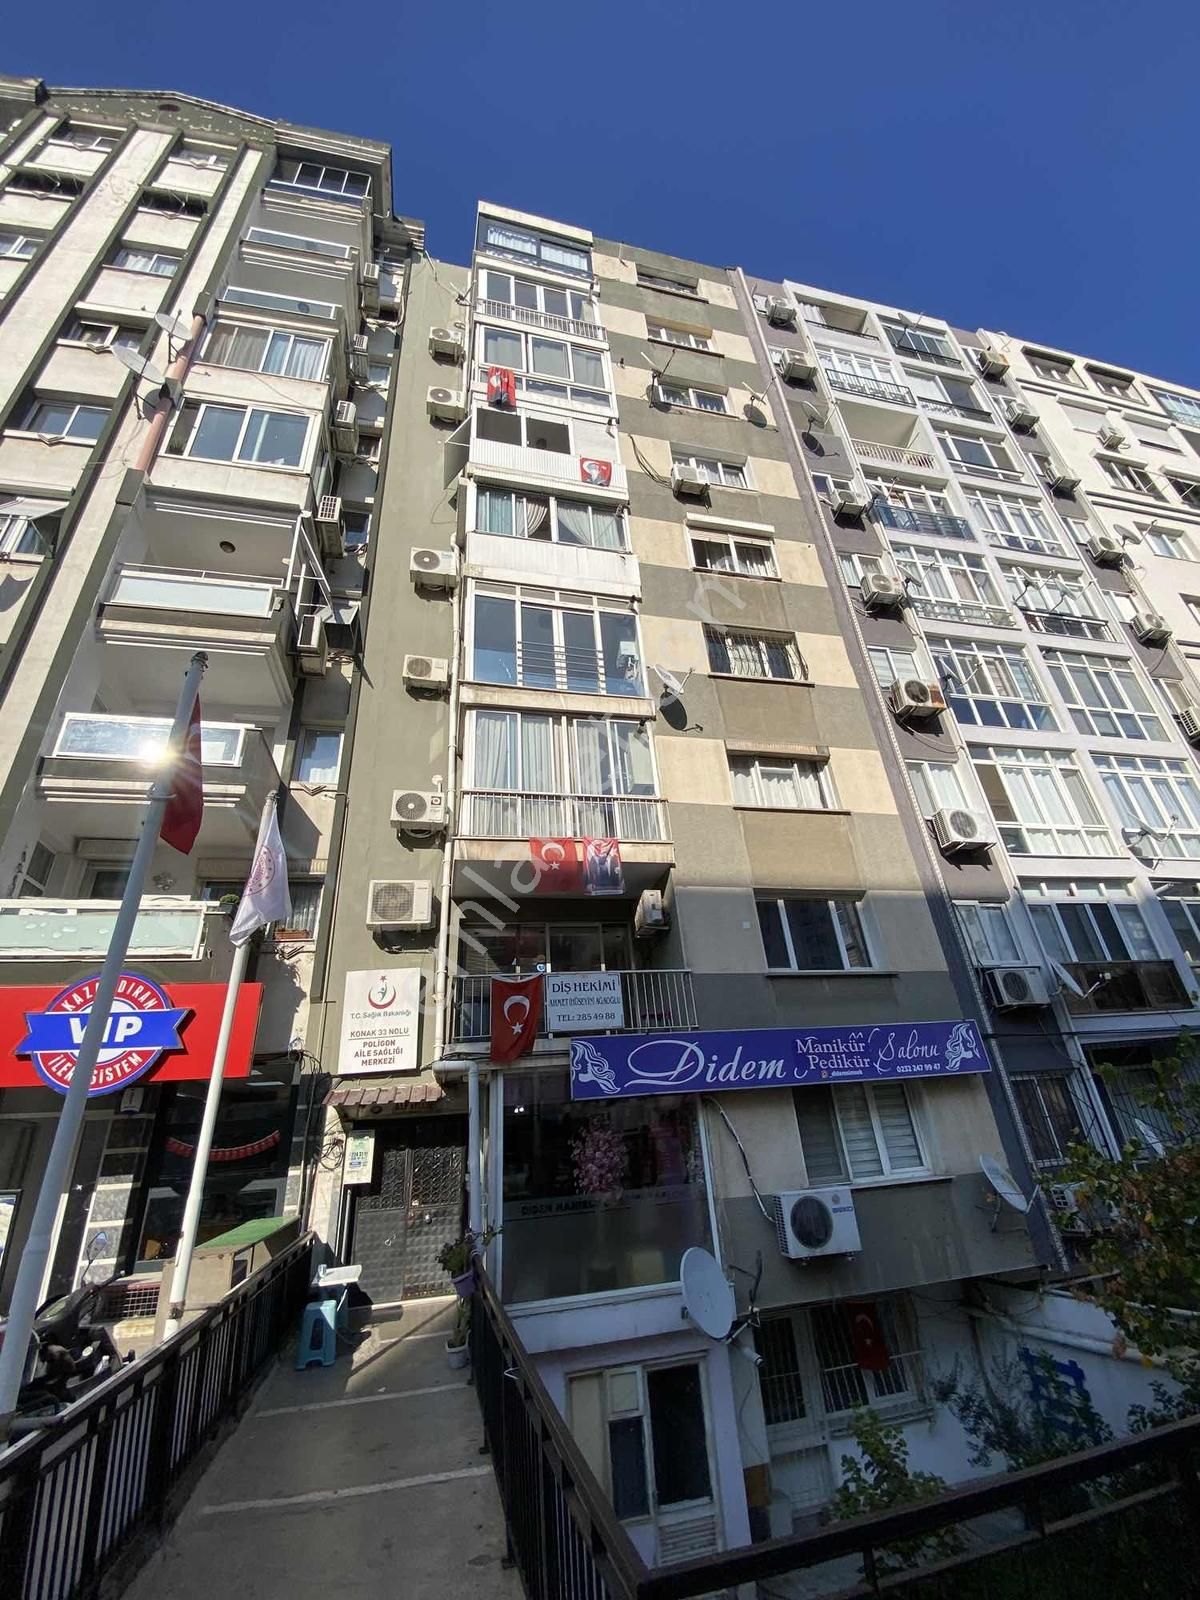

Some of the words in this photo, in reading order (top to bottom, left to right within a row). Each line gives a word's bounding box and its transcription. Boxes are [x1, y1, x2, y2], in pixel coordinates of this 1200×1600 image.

[552, 981, 571, 994] DİŞ
[574, 979, 616, 992] HEKİMİ
[61, 979, 158, 1012] KAZDIRAN
[350, 1029, 377, 1038] KONAK
[378, 1028, 387, 1036] 33
[388, 1027, 409, 1035] NOLU
[363, 1039, 396, 1048] POLİGON
[796, 1035, 866, 1054] Manikür
[877, 1029, 939, 1062] Salonu
[354, 1048, 372, 1058] AİLE
[373, 1047, 403, 1057] SAĞLIĞI
[361, 1056, 395, 1067] MERKEZİ
[624, 1039, 786, 1088] Didem
[808, 1054, 870, 1070] Pedikür
[896, 1065, 912, 1073] 0232
